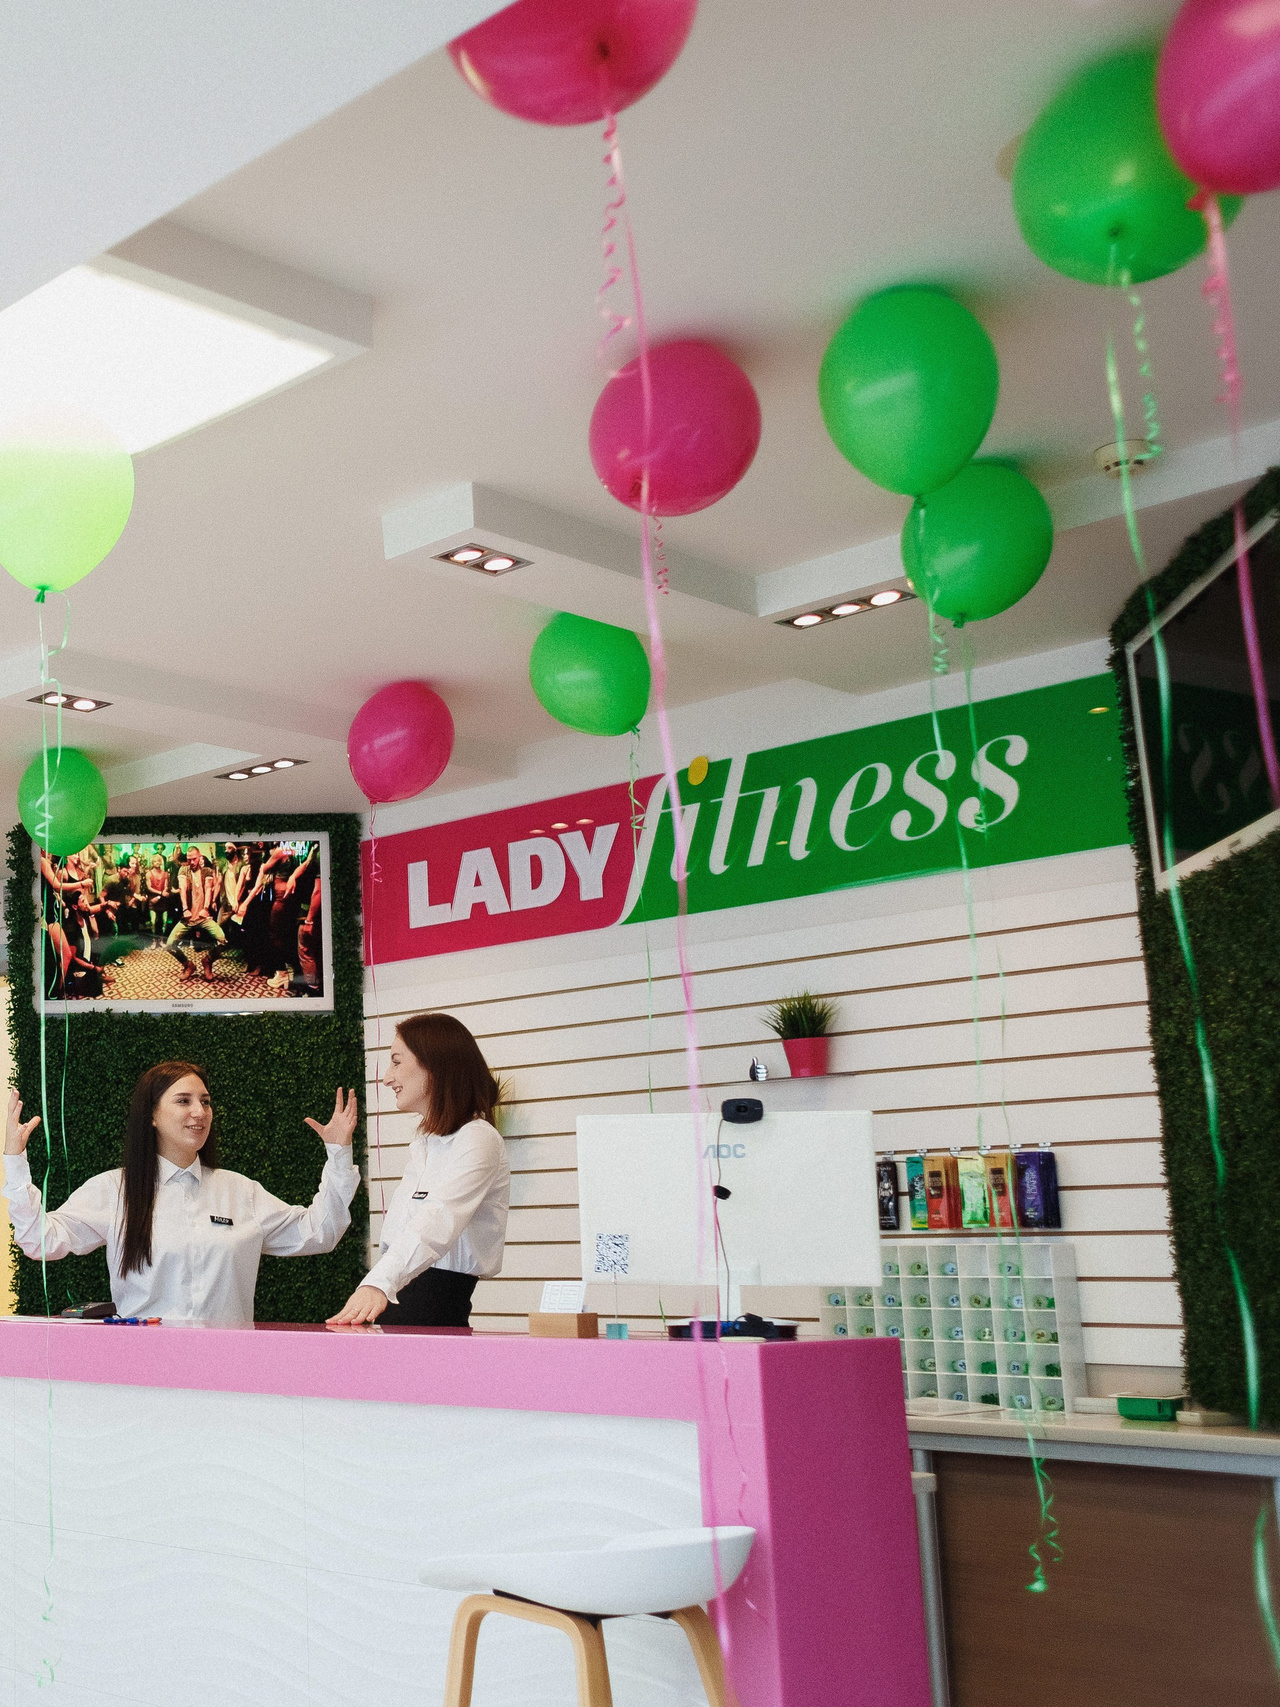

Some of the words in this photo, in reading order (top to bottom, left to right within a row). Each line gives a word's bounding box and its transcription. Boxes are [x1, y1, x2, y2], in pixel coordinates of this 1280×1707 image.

[407, 821, 619, 929] LADY
[618, 734, 1029, 926] fitness
[702, 1143, 746, 1159] AOC
